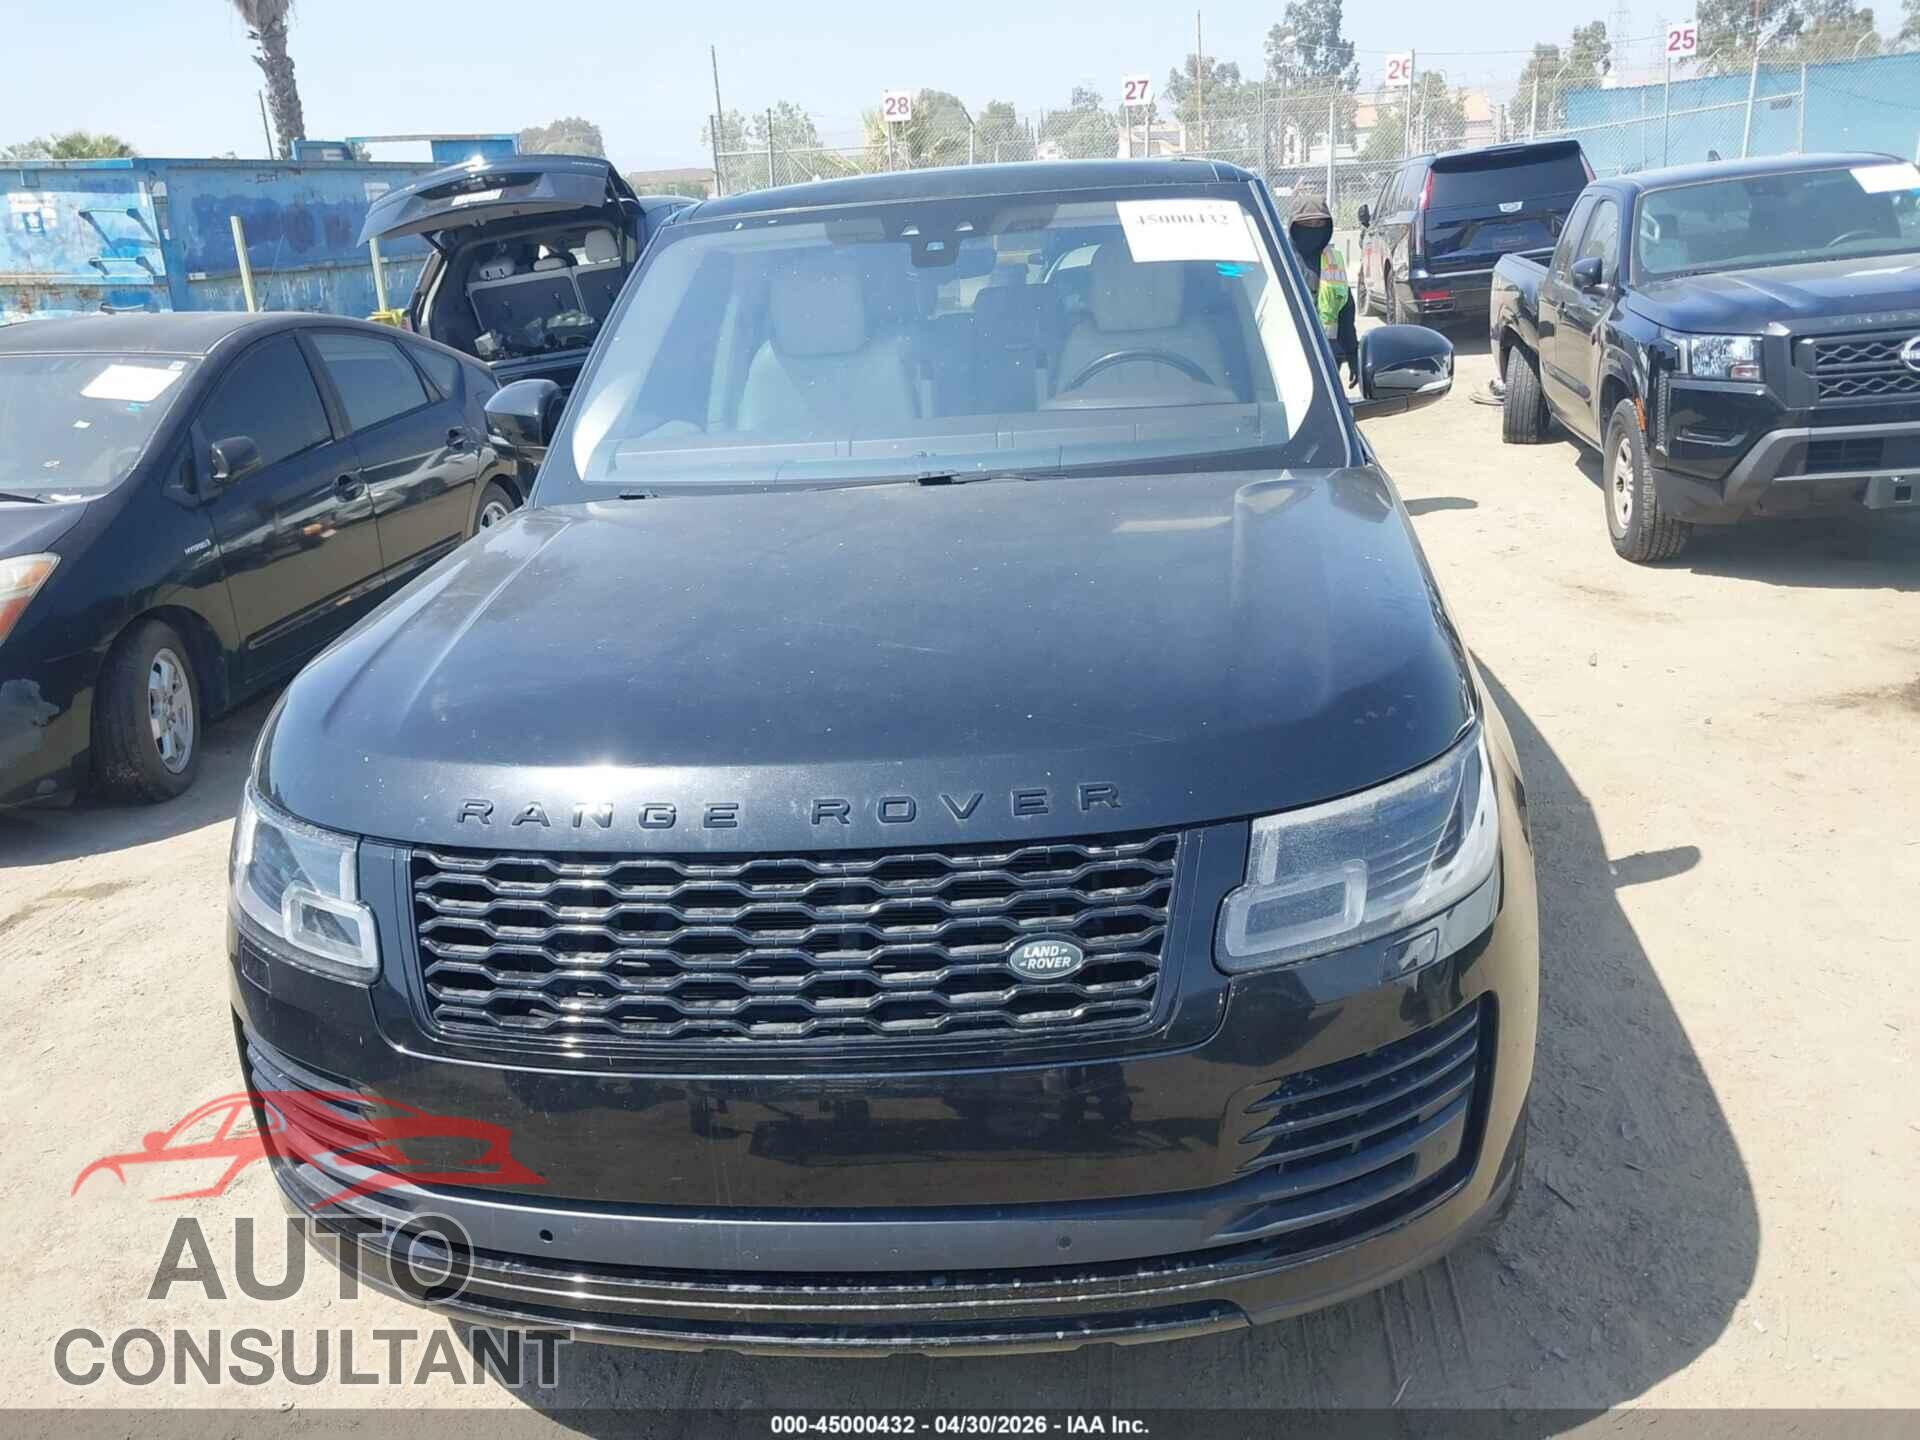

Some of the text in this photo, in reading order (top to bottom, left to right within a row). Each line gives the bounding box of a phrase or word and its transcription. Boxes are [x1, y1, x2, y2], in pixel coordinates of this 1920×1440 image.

[1668, 29, 1695, 51] 25
[1124, 80, 1149, 100] 27
[885, 97, 909, 115] 28
[456, 781, 1121, 829] RANGE ROVER
